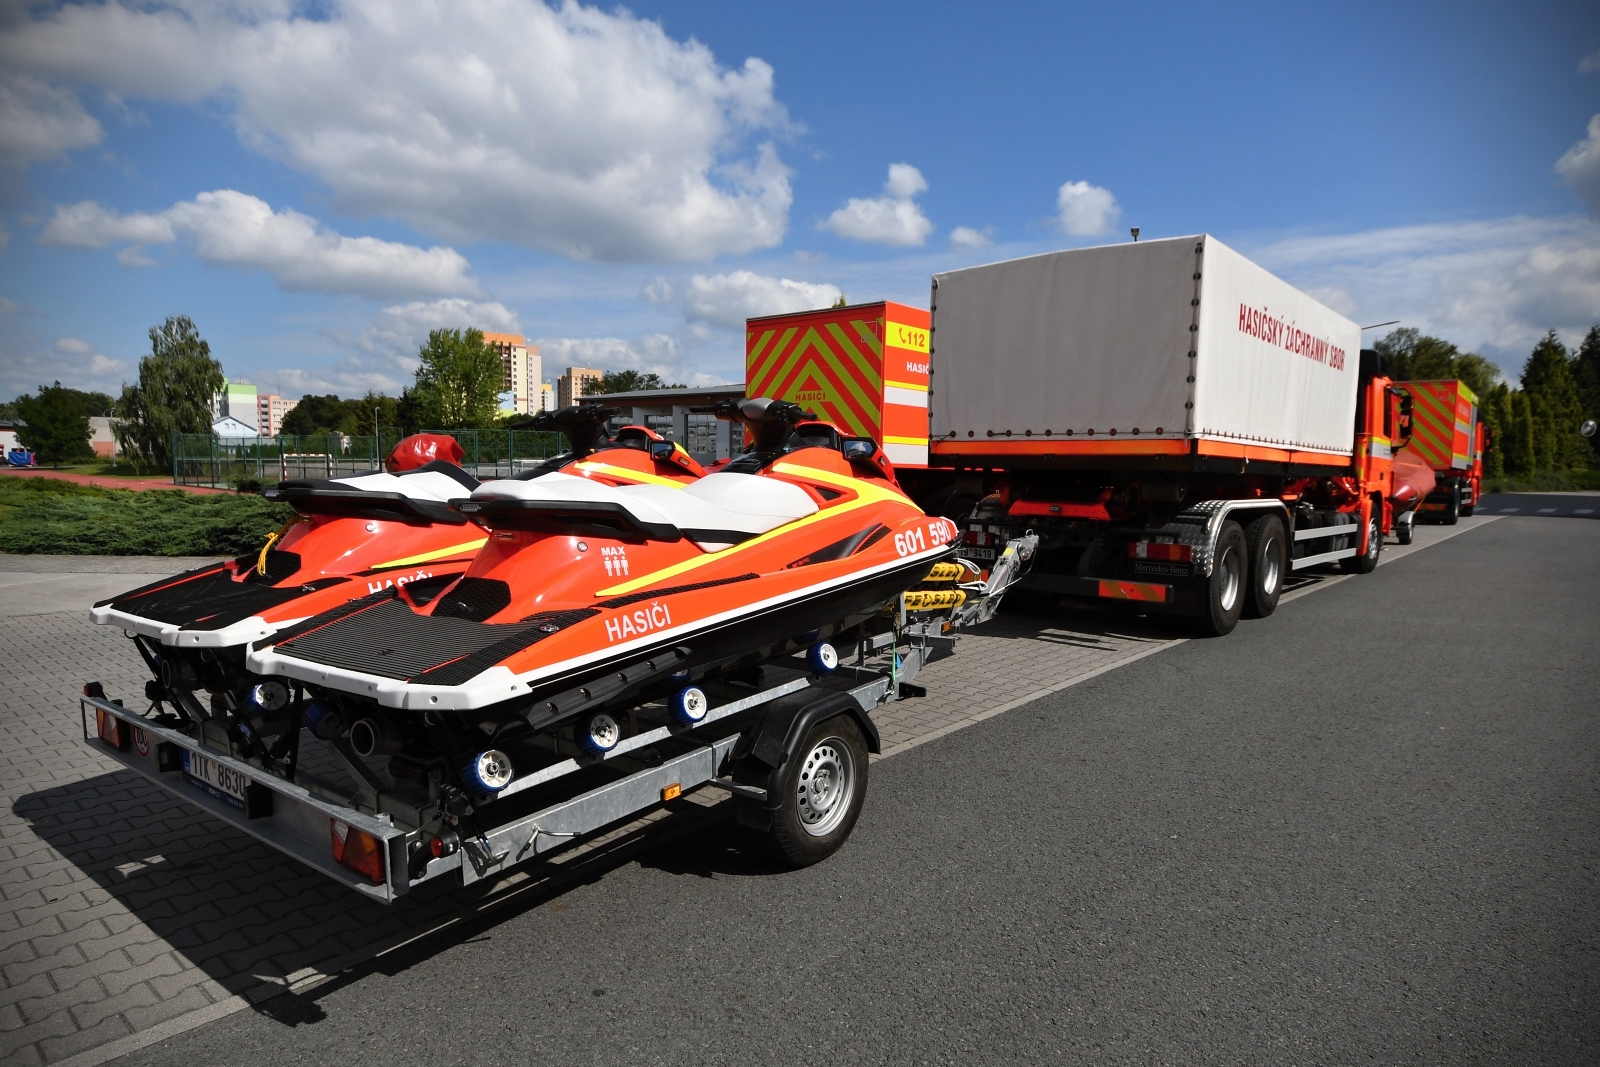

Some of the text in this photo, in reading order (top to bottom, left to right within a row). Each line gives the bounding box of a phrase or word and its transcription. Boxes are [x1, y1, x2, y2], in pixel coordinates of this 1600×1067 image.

[908, 331, 925, 348] 112
[1238, 303, 1346, 371] HASIČSKÝ ZÁCHRANNÝ SBOR
[795, 390, 826, 401] HASIČI
[894, 520, 952, 557] 601 590
[601, 546, 626, 556] MAX
[973, 549, 992, 558] 9419
[1135, 563, 1189, 575] Mercedes-Benz
[605, 601, 671, 642] HASIČI
[191, 752, 246, 798] 1TK 8630
